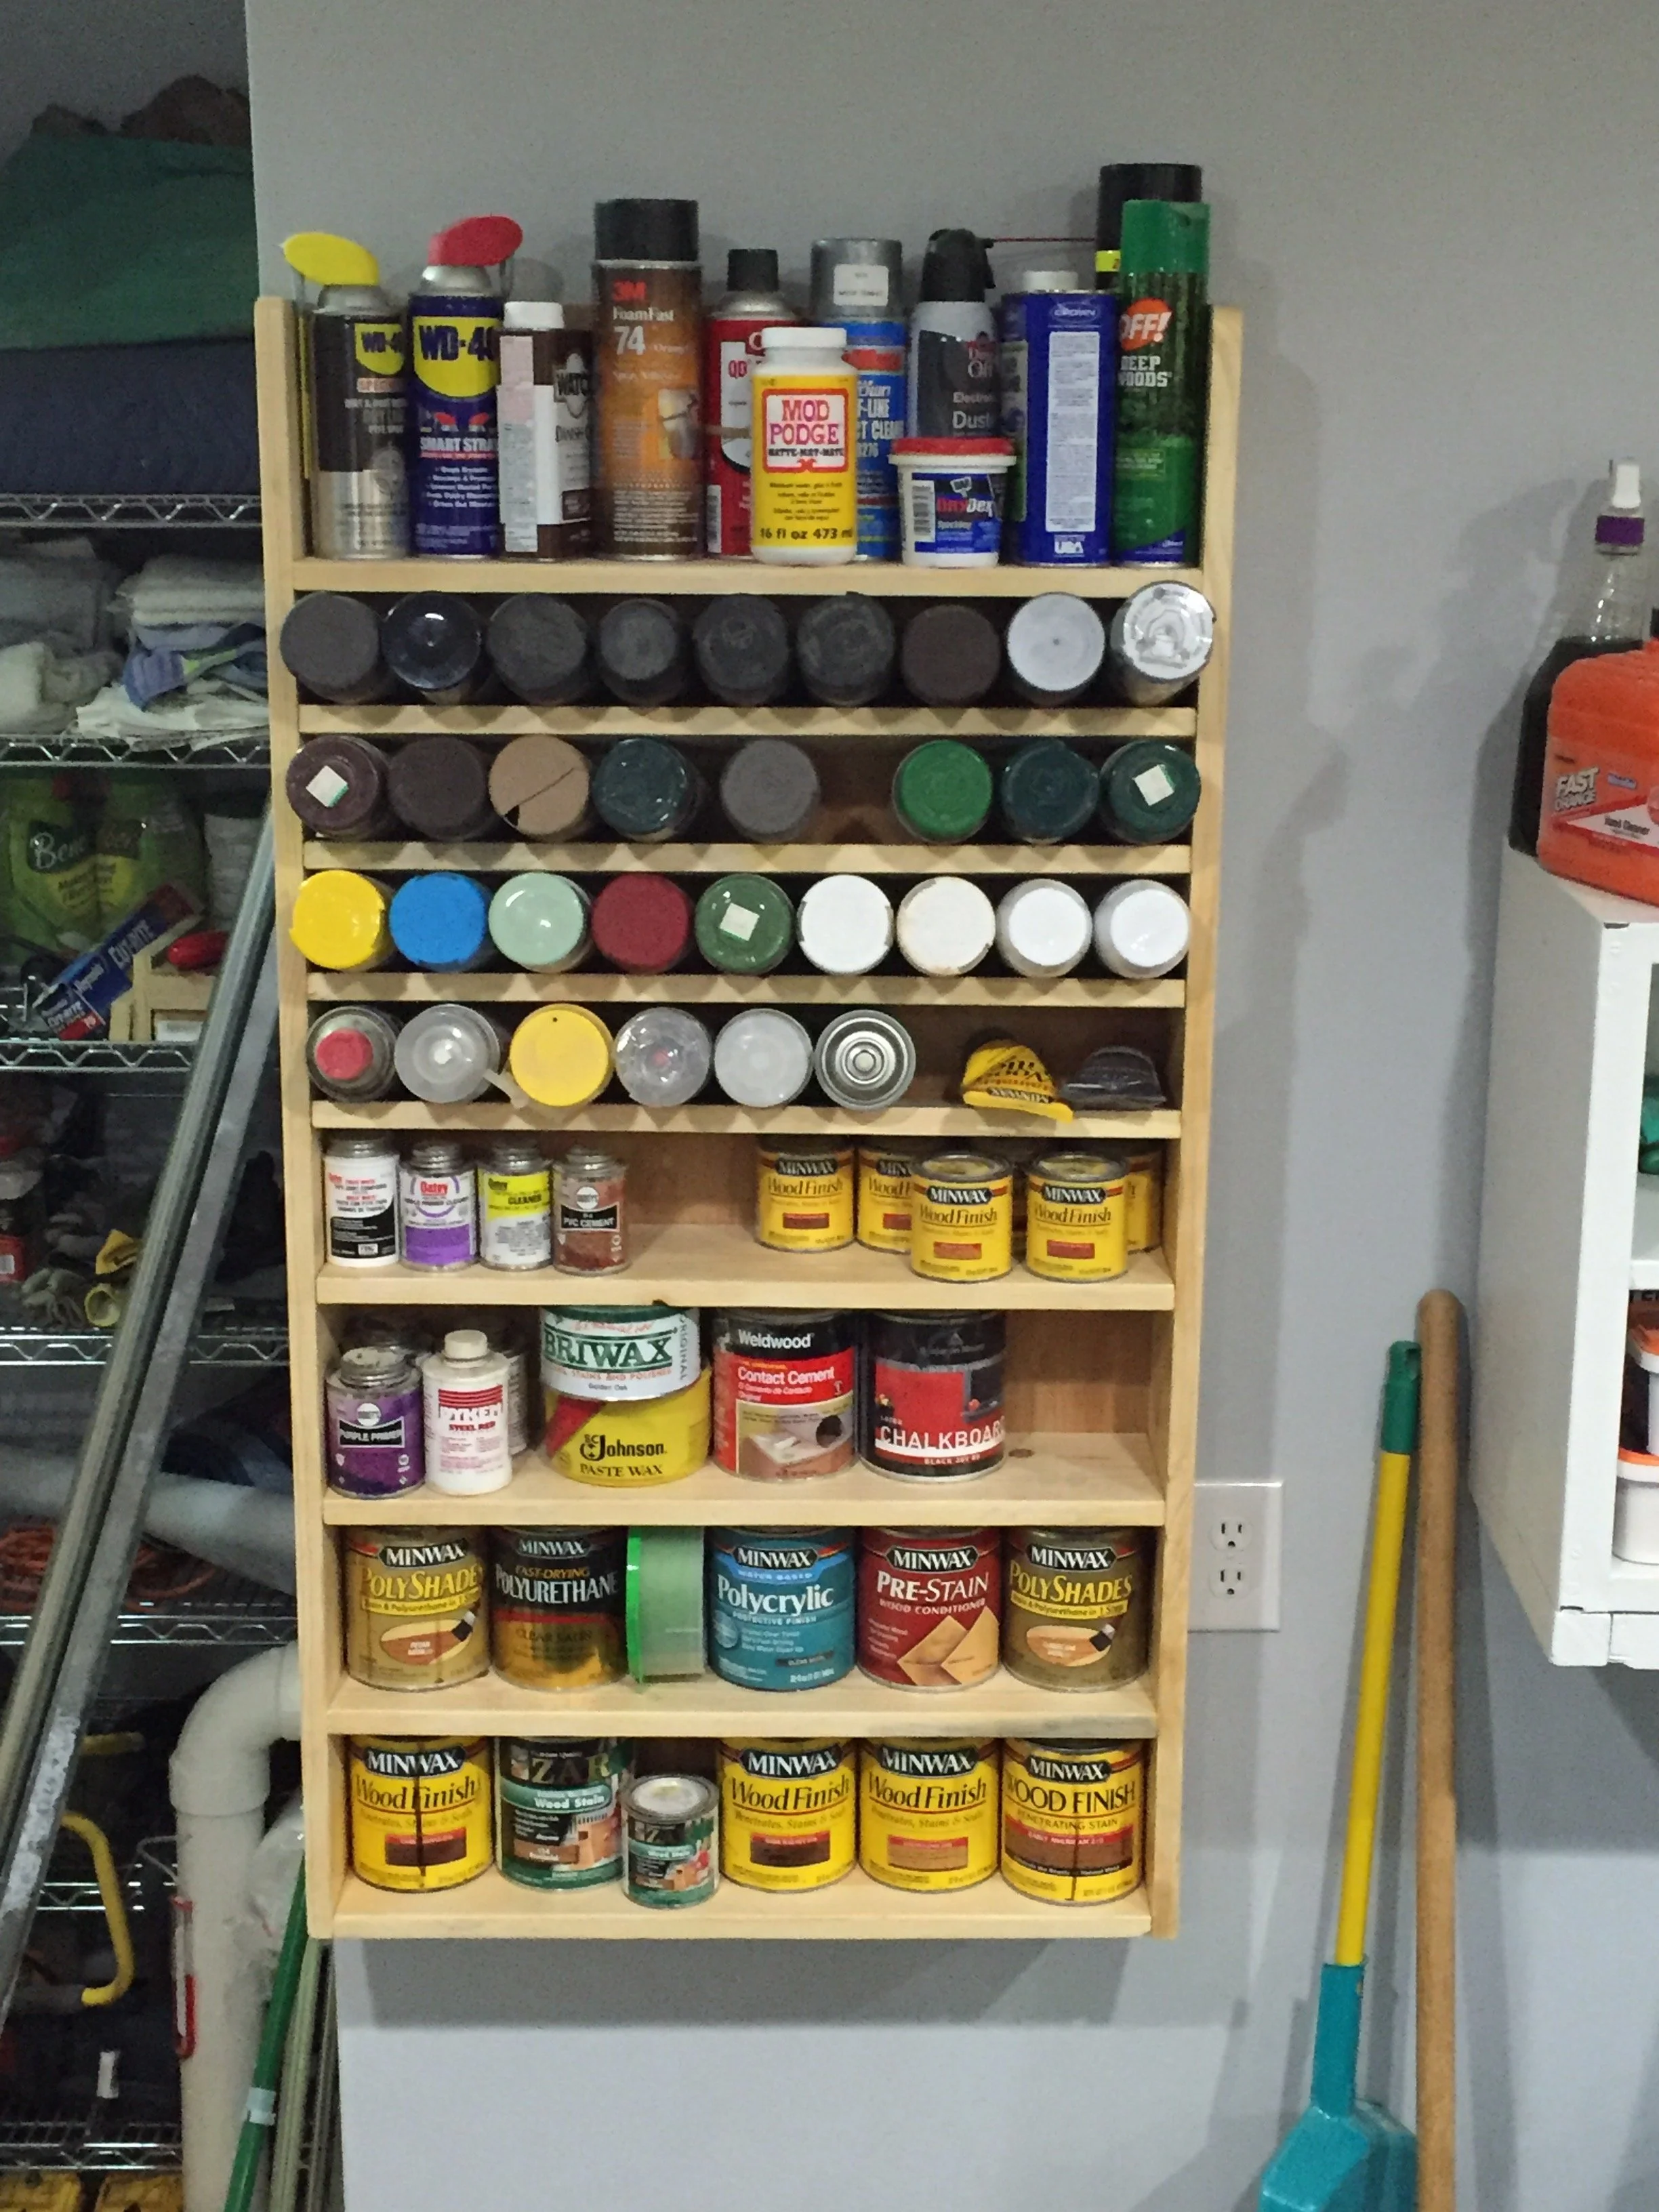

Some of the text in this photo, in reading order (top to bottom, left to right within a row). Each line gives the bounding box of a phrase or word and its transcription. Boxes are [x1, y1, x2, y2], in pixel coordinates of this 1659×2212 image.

[613, 280, 647, 300] 3M
[1119, 311, 1172, 342] OFF!
[361, 331, 405, 353] WD-4
[614, 325, 646, 355] 74
[1121, 355, 1162, 371] DEEP
[1118, 371, 1169, 387] WOODS
[781, 399, 830, 422] MOD
[769, 423, 840, 445] PODGE
[760, 528, 773, 539] 16
[777, 528, 787, 539] fl
[791, 531, 808, 539] oz
[813, 527, 838, 539] 473
[1557, 766, 1601, 798] FAST
[779, 1160, 835, 1175] MINWAX
[880, 1160, 911, 1176] MIN
[930, 1187, 988, 1204] MINWAX
[1044, 1186, 1102, 1202] MINWAX
[920, 1204, 998, 1225] Wood Finish
[1069, 1206, 1111, 1224] Finish
[544, 1328, 673, 1368] BRIWAX
[737, 1328, 812, 1349] Weldwood
[737, 1366, 835, 1385] Contact Cement
[579, 1434, 665, 1461] Johnson
[579, 1463, 663, 1477] PASTE WAX
[386, 1542, 466, 1566] MINWAX
[518, 1538, 585, 1555] MINWAX
[1031, 1545, 1111, 1569] MINWAX
[737, 1547, 813, 1569] MINWAX
[894, 1549, 972, 1570] MINWAX
[495, 1563, 619, 1604] POLYURETHANE
[516, 1565, 591, 1580] FAST-DRYING
[717, 1574, 834, 1617] Polycrylic
[876, 1570, 989, 1603] PRE-STAIN
[879, 1598, 912, 1614] WOOD
[748, 1750, 837, 1776] MINWAX
[882, 1747, 972, 1774] MINWAX
[1030, 1758, 1105, 1781] MINWAX
[356, 1775, 408, 1810] Wood
[731, 1774, 850, 1811] Wood Finish
[868, 1770, 987, 1809] Wood Finish
[1007, 1770, 1136, 1814] WOOD FINISH
[534, 1795, 605, 1809] Wood Stain
[1088, 1818, 1118, 1829] STAIN
